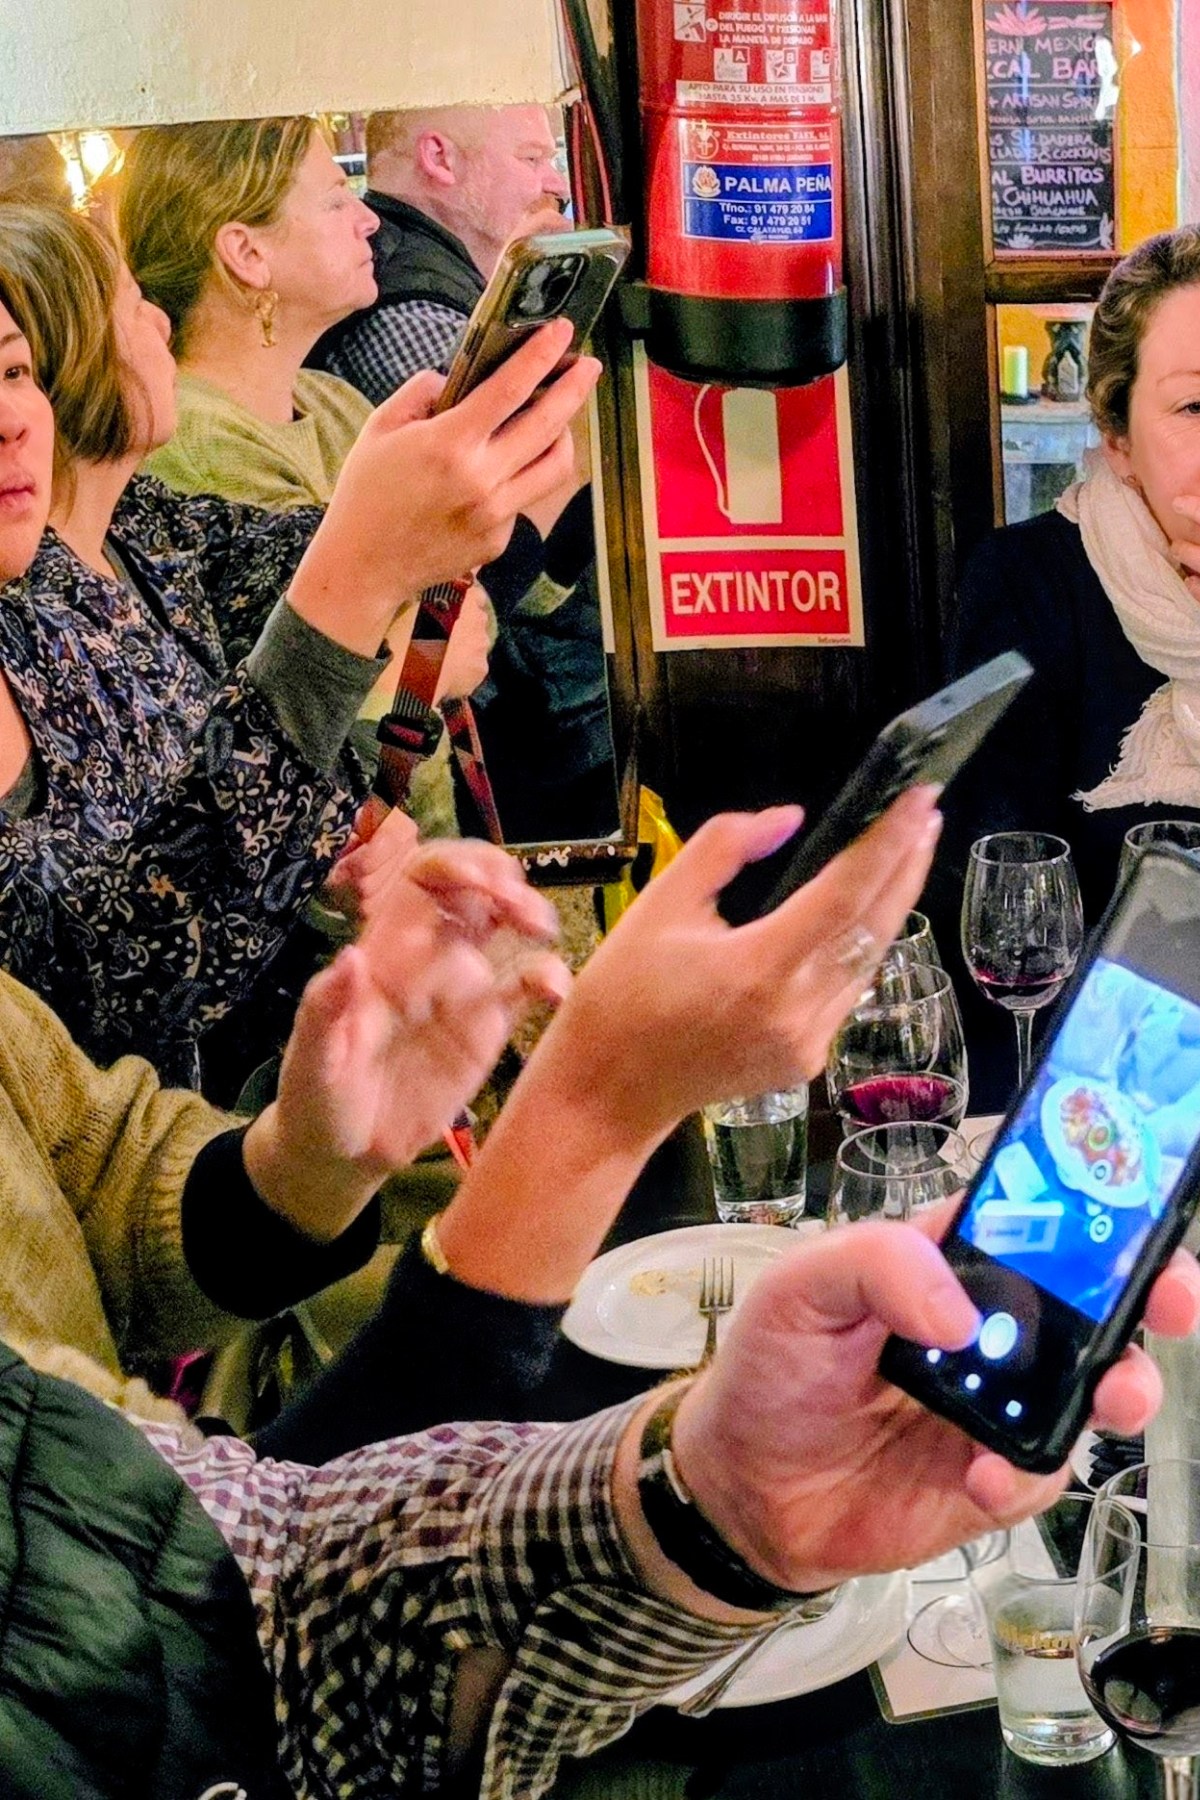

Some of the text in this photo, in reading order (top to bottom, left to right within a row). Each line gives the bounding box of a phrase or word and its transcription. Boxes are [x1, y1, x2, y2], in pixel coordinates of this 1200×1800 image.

[735, 52, 745, 62] A
[786, 53, 794, 62] B
[712, 83, 736, 92] PARA
[739, 84, 751, 93] SU
[753, 84, 773, 93] USO
[774, 85, 786, 93] EN
[727, 130, 790, 140] Extintores
[725, 174, 832, 193] PALMA PEÑA
[754, 204, 767, 214] 91
[769, 204, 789, 214] 479
[790, 204, 803, 214] 20
[804, 204, 815, 213] 84
[723, 214, 811, 226] Fax: 91 479 20 51
[670, 569, 841, 615] EXTINTOR
